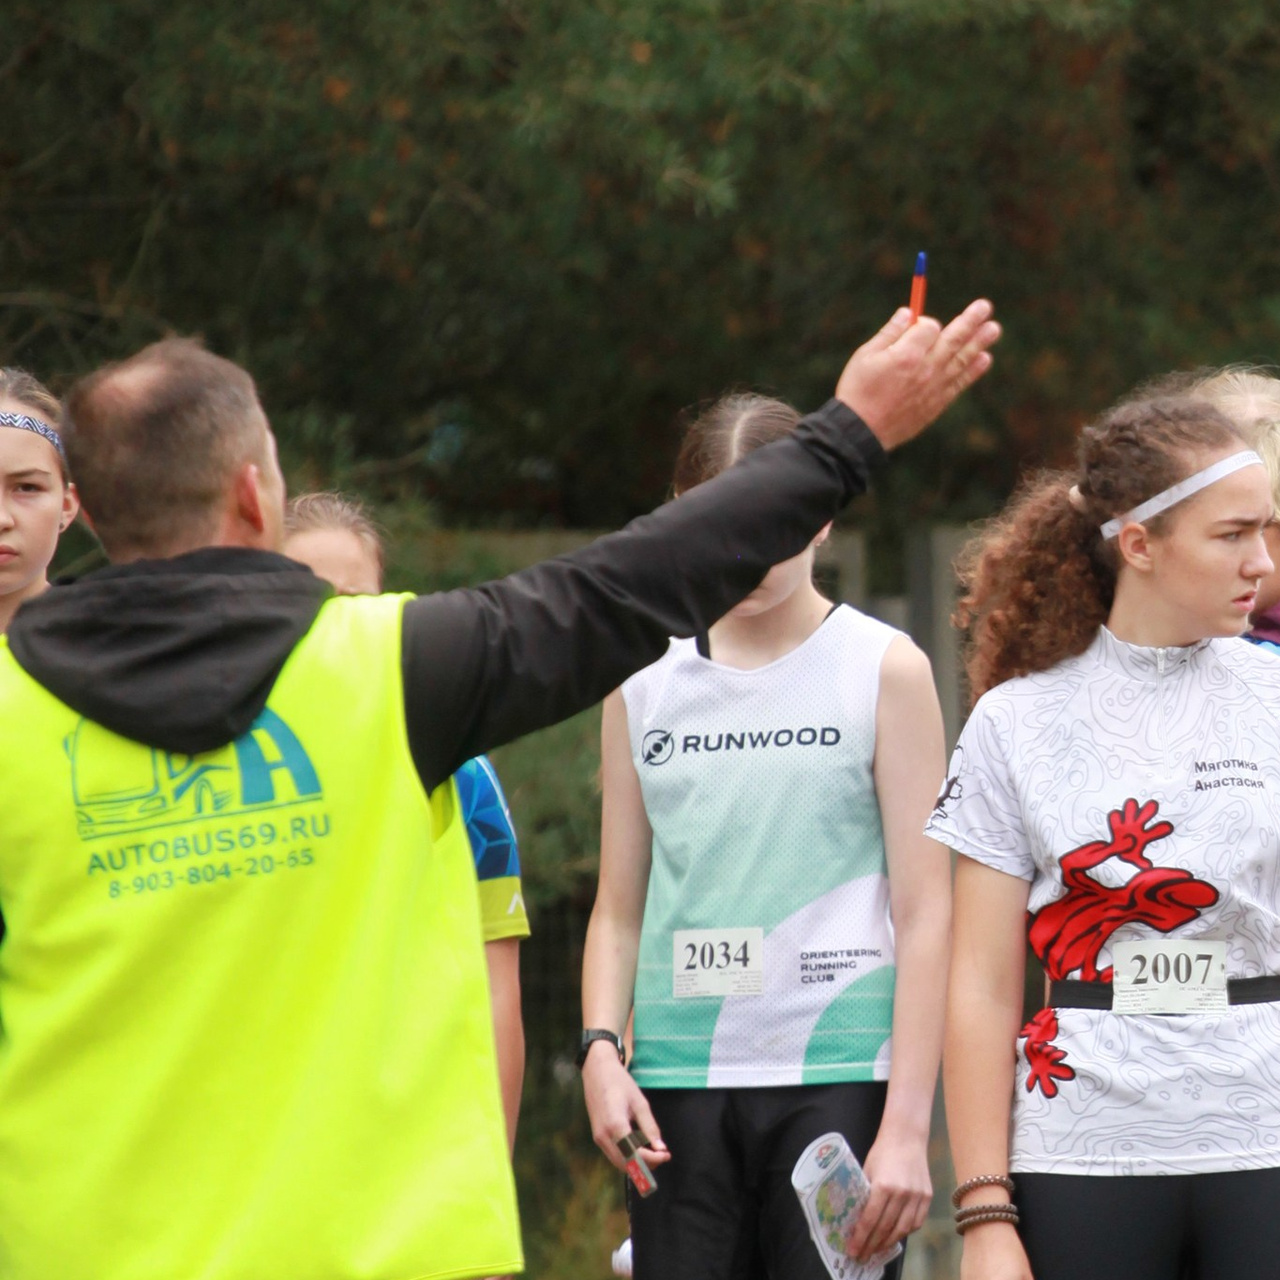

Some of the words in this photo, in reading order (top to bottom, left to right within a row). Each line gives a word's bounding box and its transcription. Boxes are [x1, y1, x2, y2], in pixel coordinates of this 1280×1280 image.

[682, 727, 841, 753] RUNWOOD
[1194, 759, 1258, 773] Мяготина
[1194, 777, 1265, 792] Анастасия
[88, 814, 330, 875] AUTOBUS69.RU
[108, 848, 315, 898] 8-903-804-20-65
[684, 940, 750, 970] 2034
[800, 949, 882, 960] ORIENTEERING
[800, 960, 857, 972] RUNNING
[1130, 953, 1213, 985] 2007
[801, 973, 835, 984] CLUB
